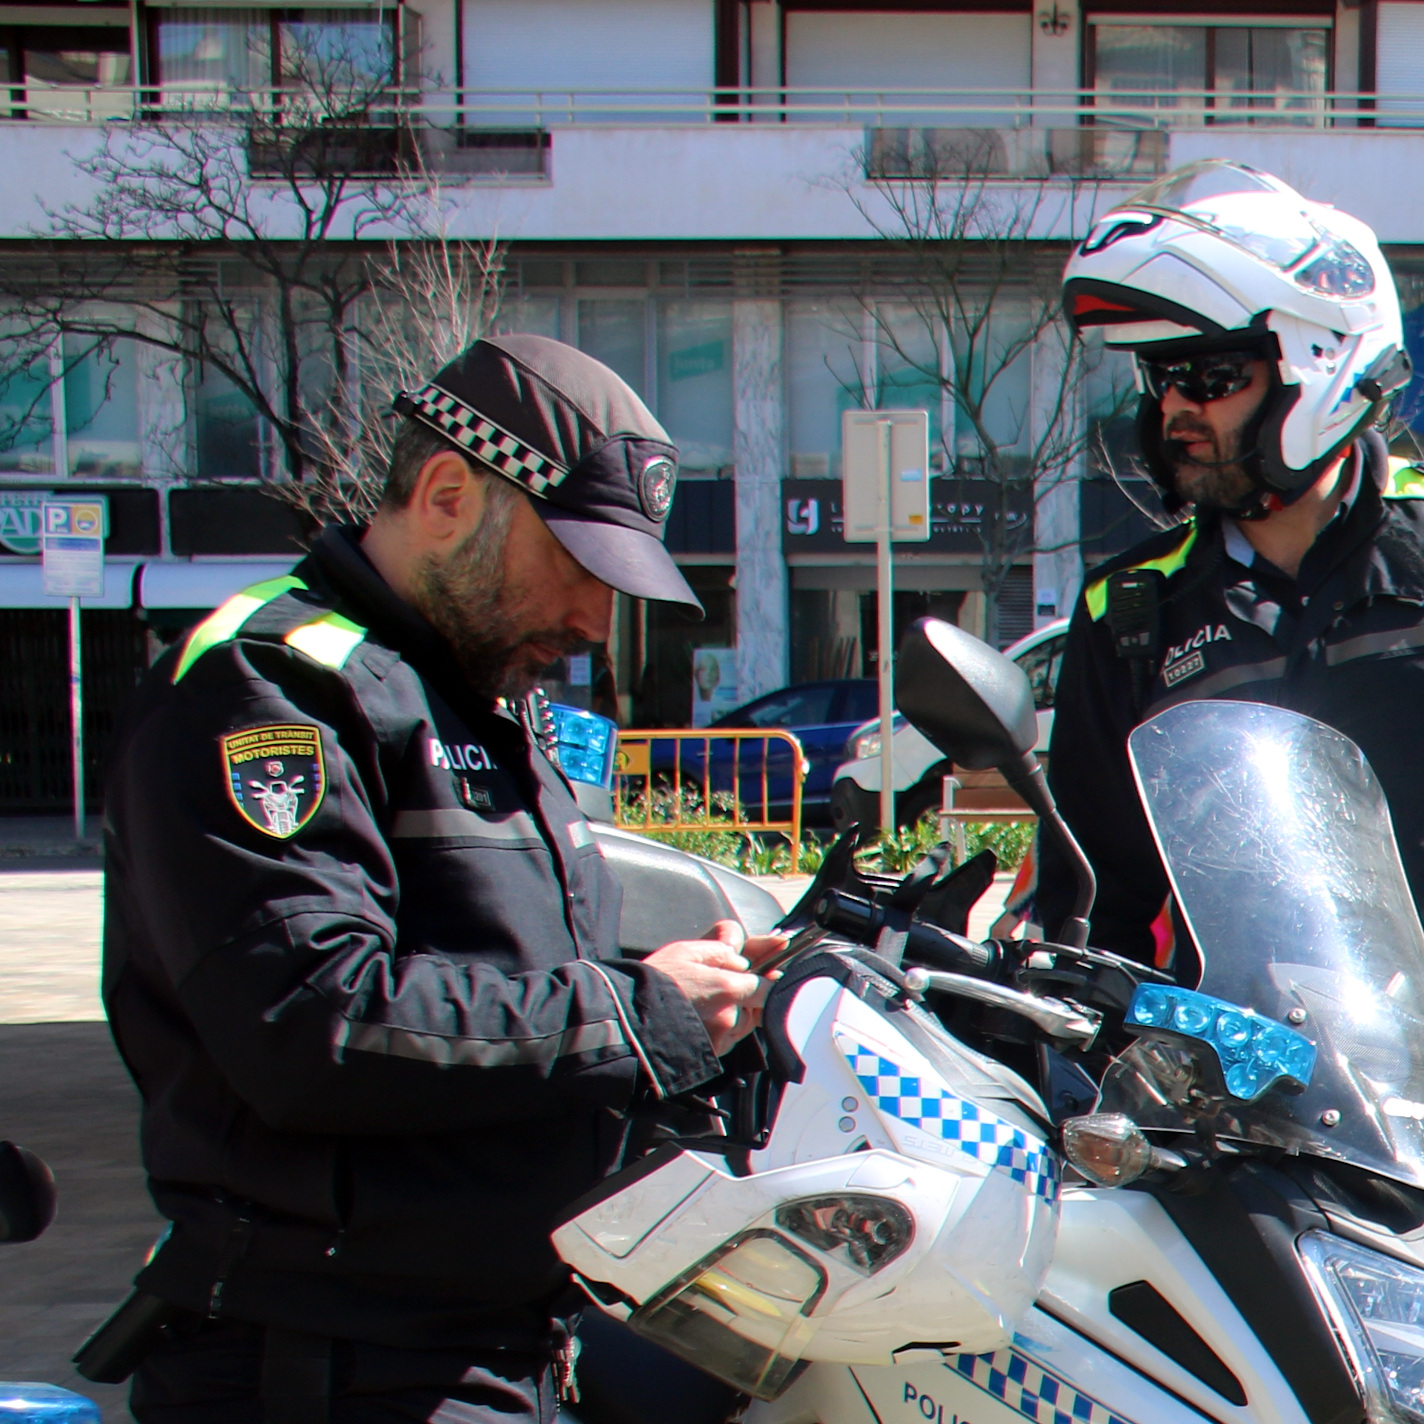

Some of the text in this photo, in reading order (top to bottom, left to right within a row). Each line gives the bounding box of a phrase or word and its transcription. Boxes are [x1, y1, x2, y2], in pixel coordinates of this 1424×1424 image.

[48, 508, 68, 534] P
[228, 735, 259, 749] UNITAT
[261, 732, 274, 741] DE
[230, 745, 315, 764] MOTORISTES
